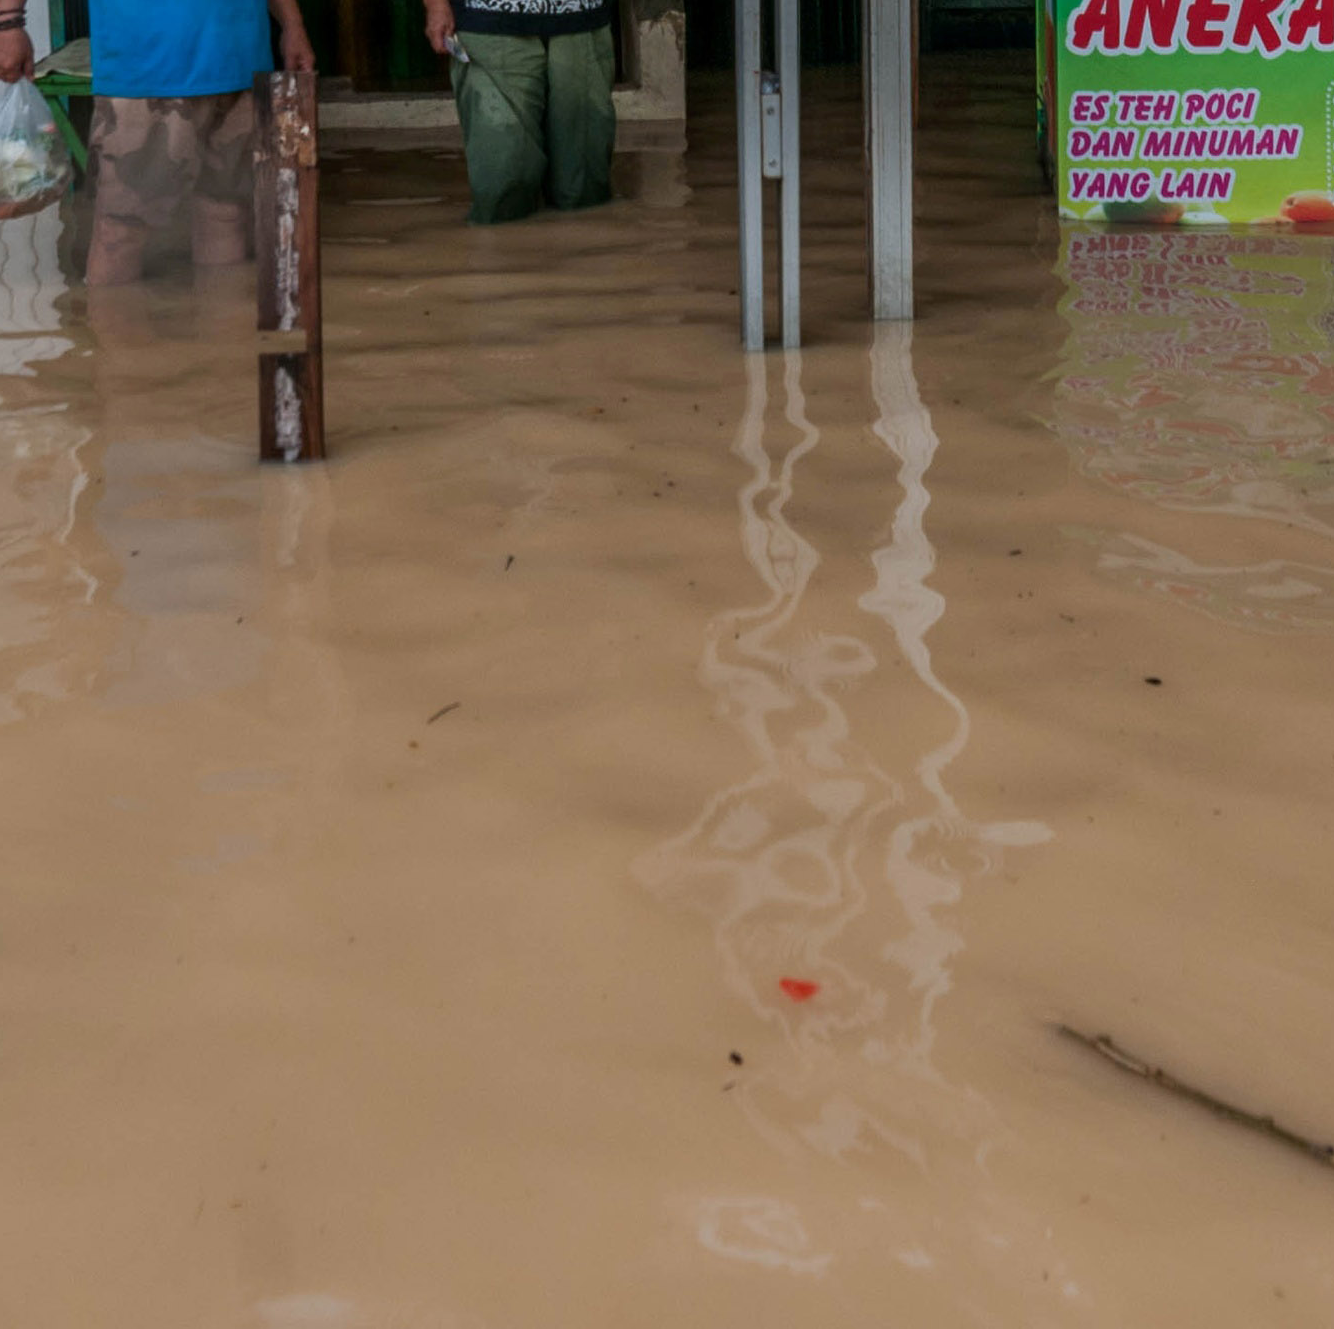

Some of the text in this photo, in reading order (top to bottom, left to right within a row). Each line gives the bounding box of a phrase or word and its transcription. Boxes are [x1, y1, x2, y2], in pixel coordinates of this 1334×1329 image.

[1073, 91, 1255, 122] ES TEH POCI
[1069, 128, 1300, 158] DAN MINUMAN
[1070, 172, 1232, 199] YANG LAIN
